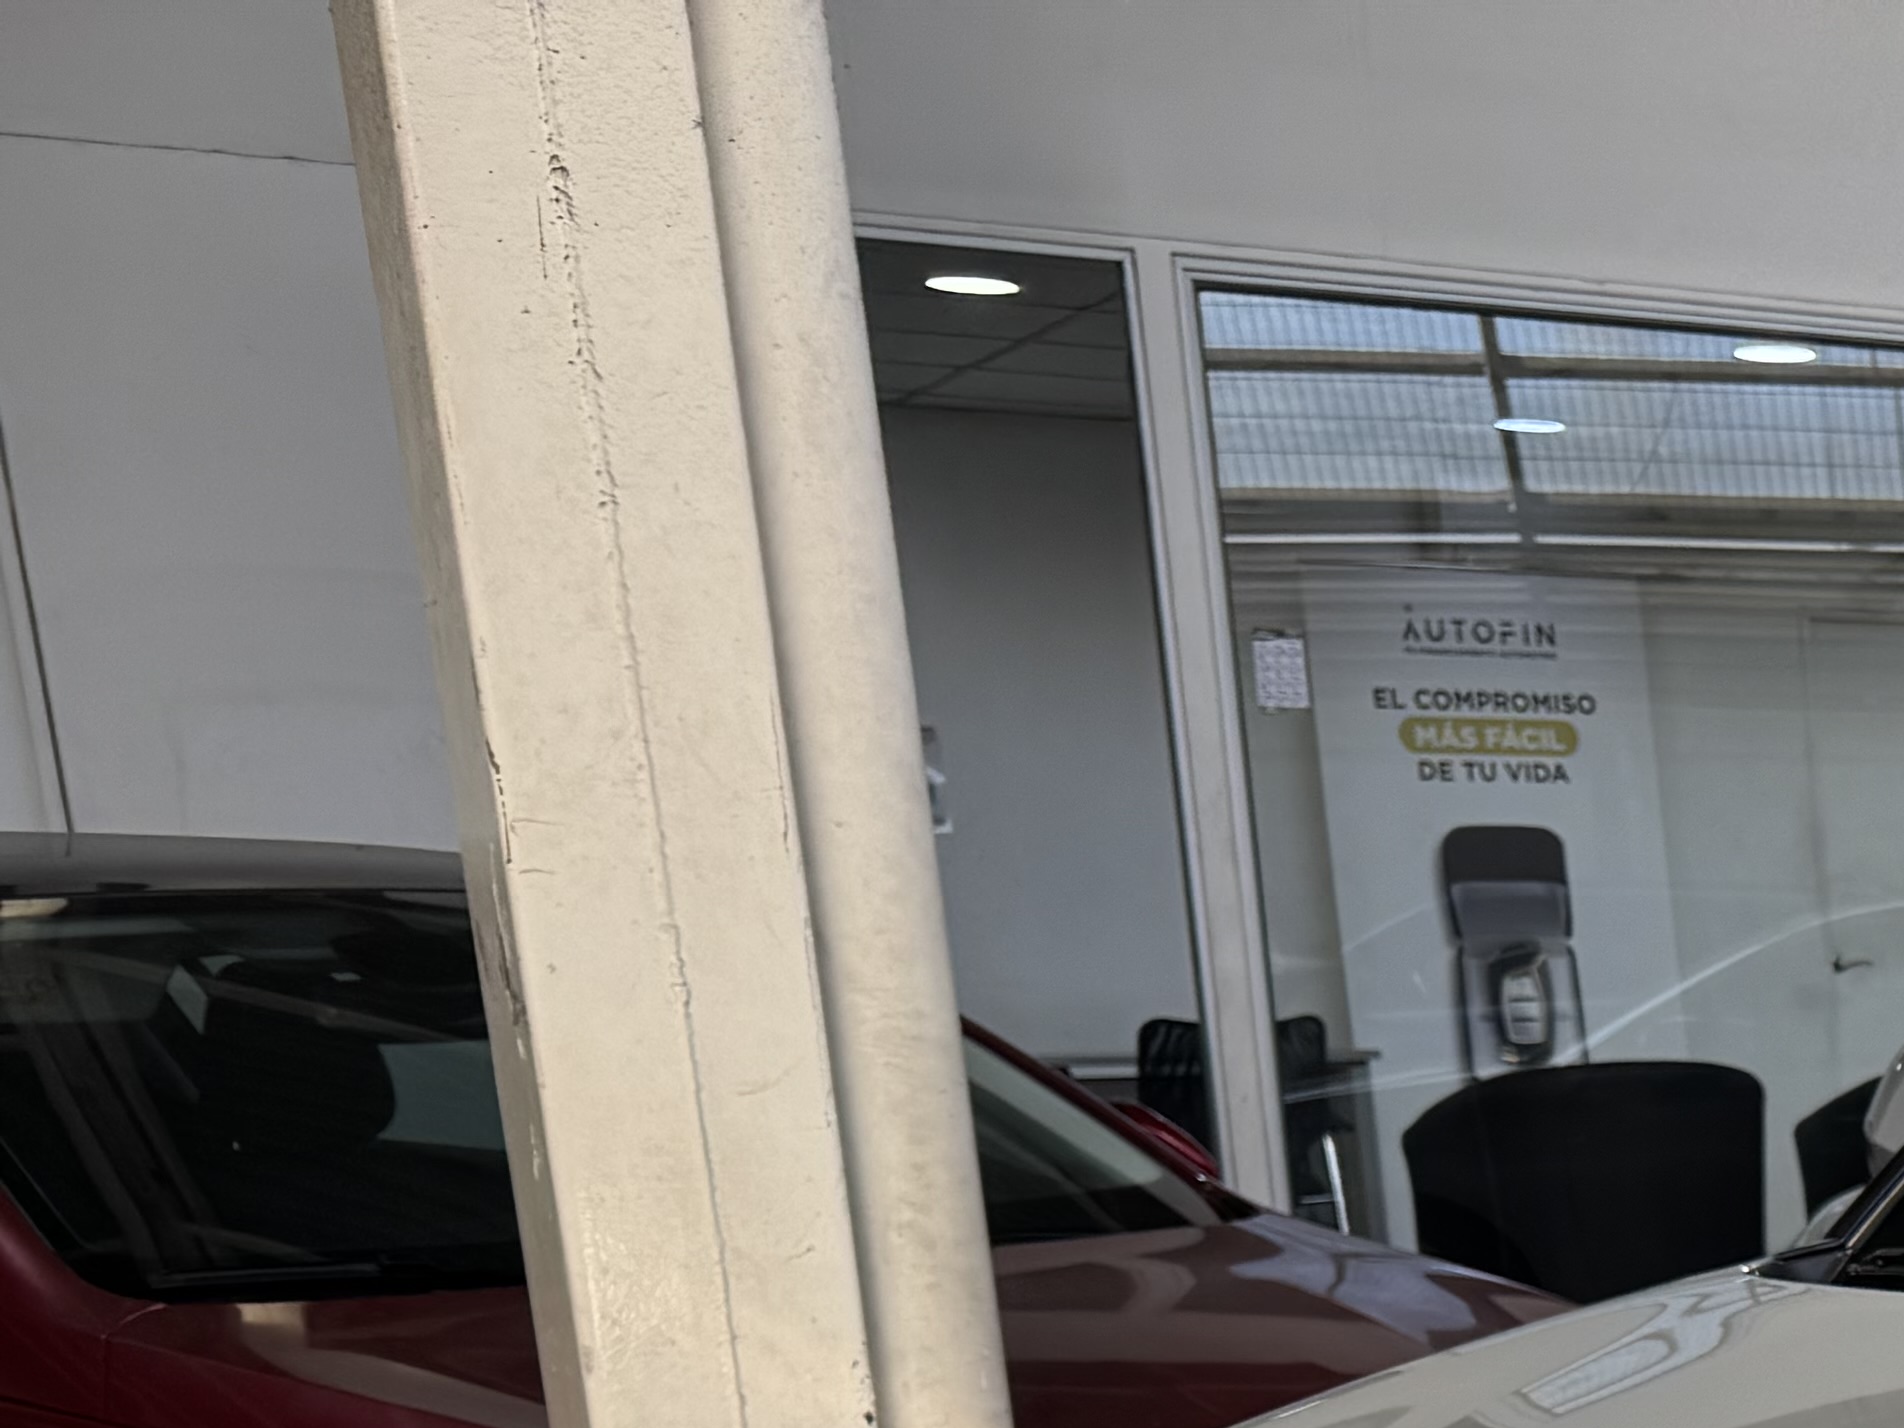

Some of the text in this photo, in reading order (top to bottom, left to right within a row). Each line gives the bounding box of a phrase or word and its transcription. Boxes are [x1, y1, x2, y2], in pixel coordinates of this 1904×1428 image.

[1403, 618, 1557, 646] AUTOFIN
[1373, 687, 1597, 715] EL COMPROMISO
[1413, 720, 1567, 751] MÁS FÁCIL
[1417, 760, 1570, 784] DE TU VIDA
